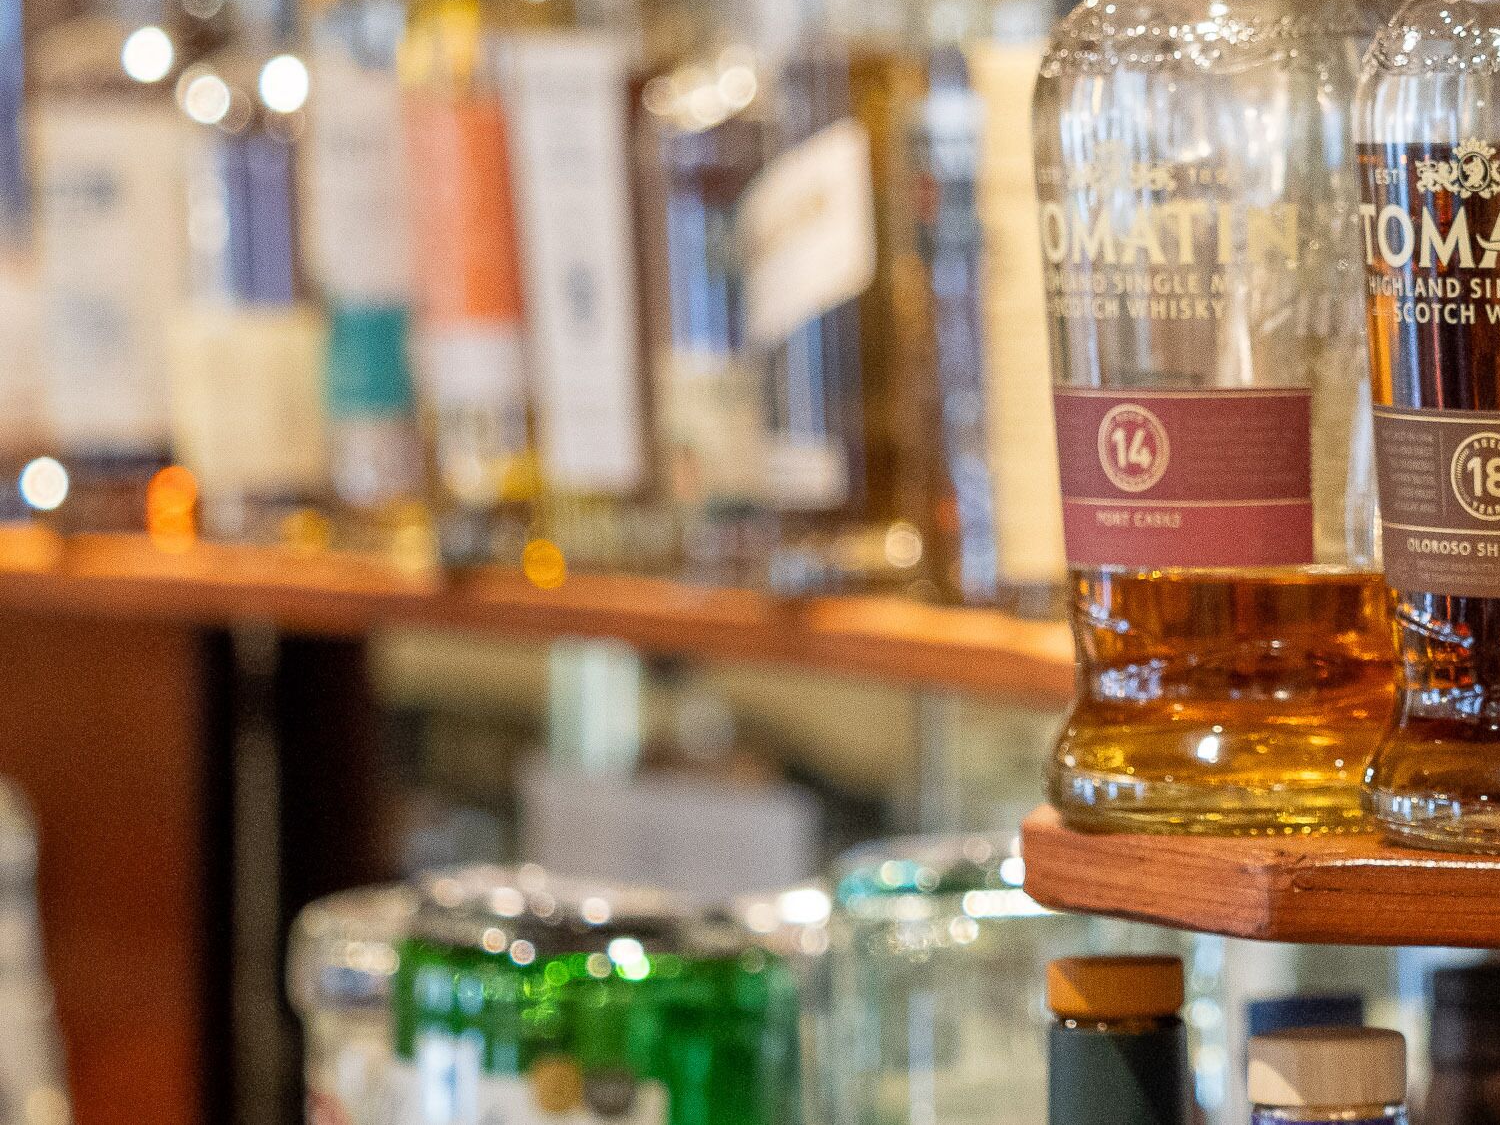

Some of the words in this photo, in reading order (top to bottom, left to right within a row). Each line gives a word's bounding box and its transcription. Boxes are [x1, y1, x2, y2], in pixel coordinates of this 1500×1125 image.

[1040, 202, 1300, 266] OMATIN
[1368, 276, 1462, 298] HIGHLAND
[1394, 302, 1476, 325] SCOTCH
[1109, 426, 1153, 471] 14
[1406, 537, 1472, 556] OLOROSO
